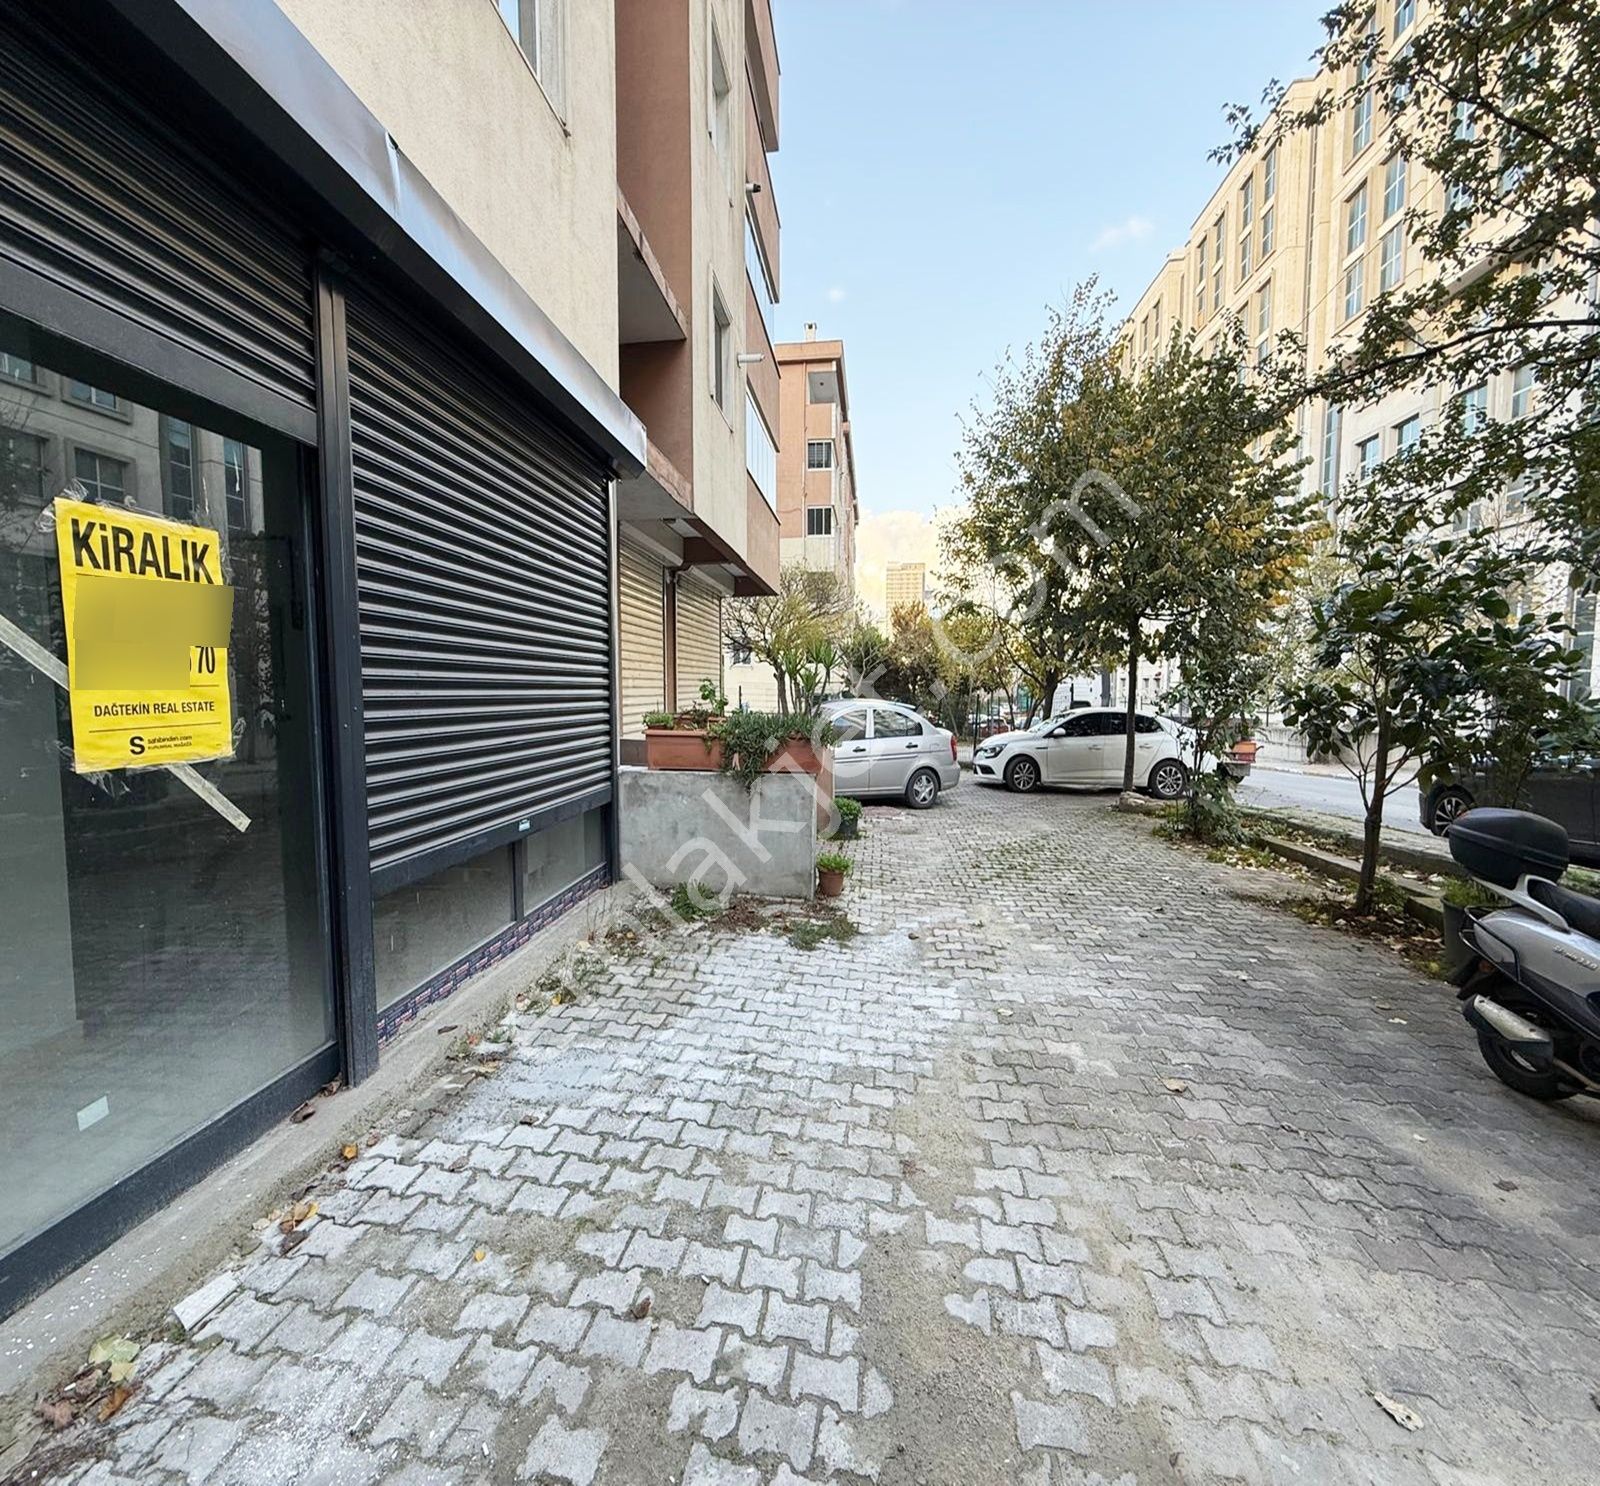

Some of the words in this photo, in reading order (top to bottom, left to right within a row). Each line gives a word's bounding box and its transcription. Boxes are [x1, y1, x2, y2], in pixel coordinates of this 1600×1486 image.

[94, 702, 150, 717] DAĞTEKİN
[153, 703, 180, 714] REAL
[181, 701, 216, 713] ESTATE
[129, 736, 145, 755] S
